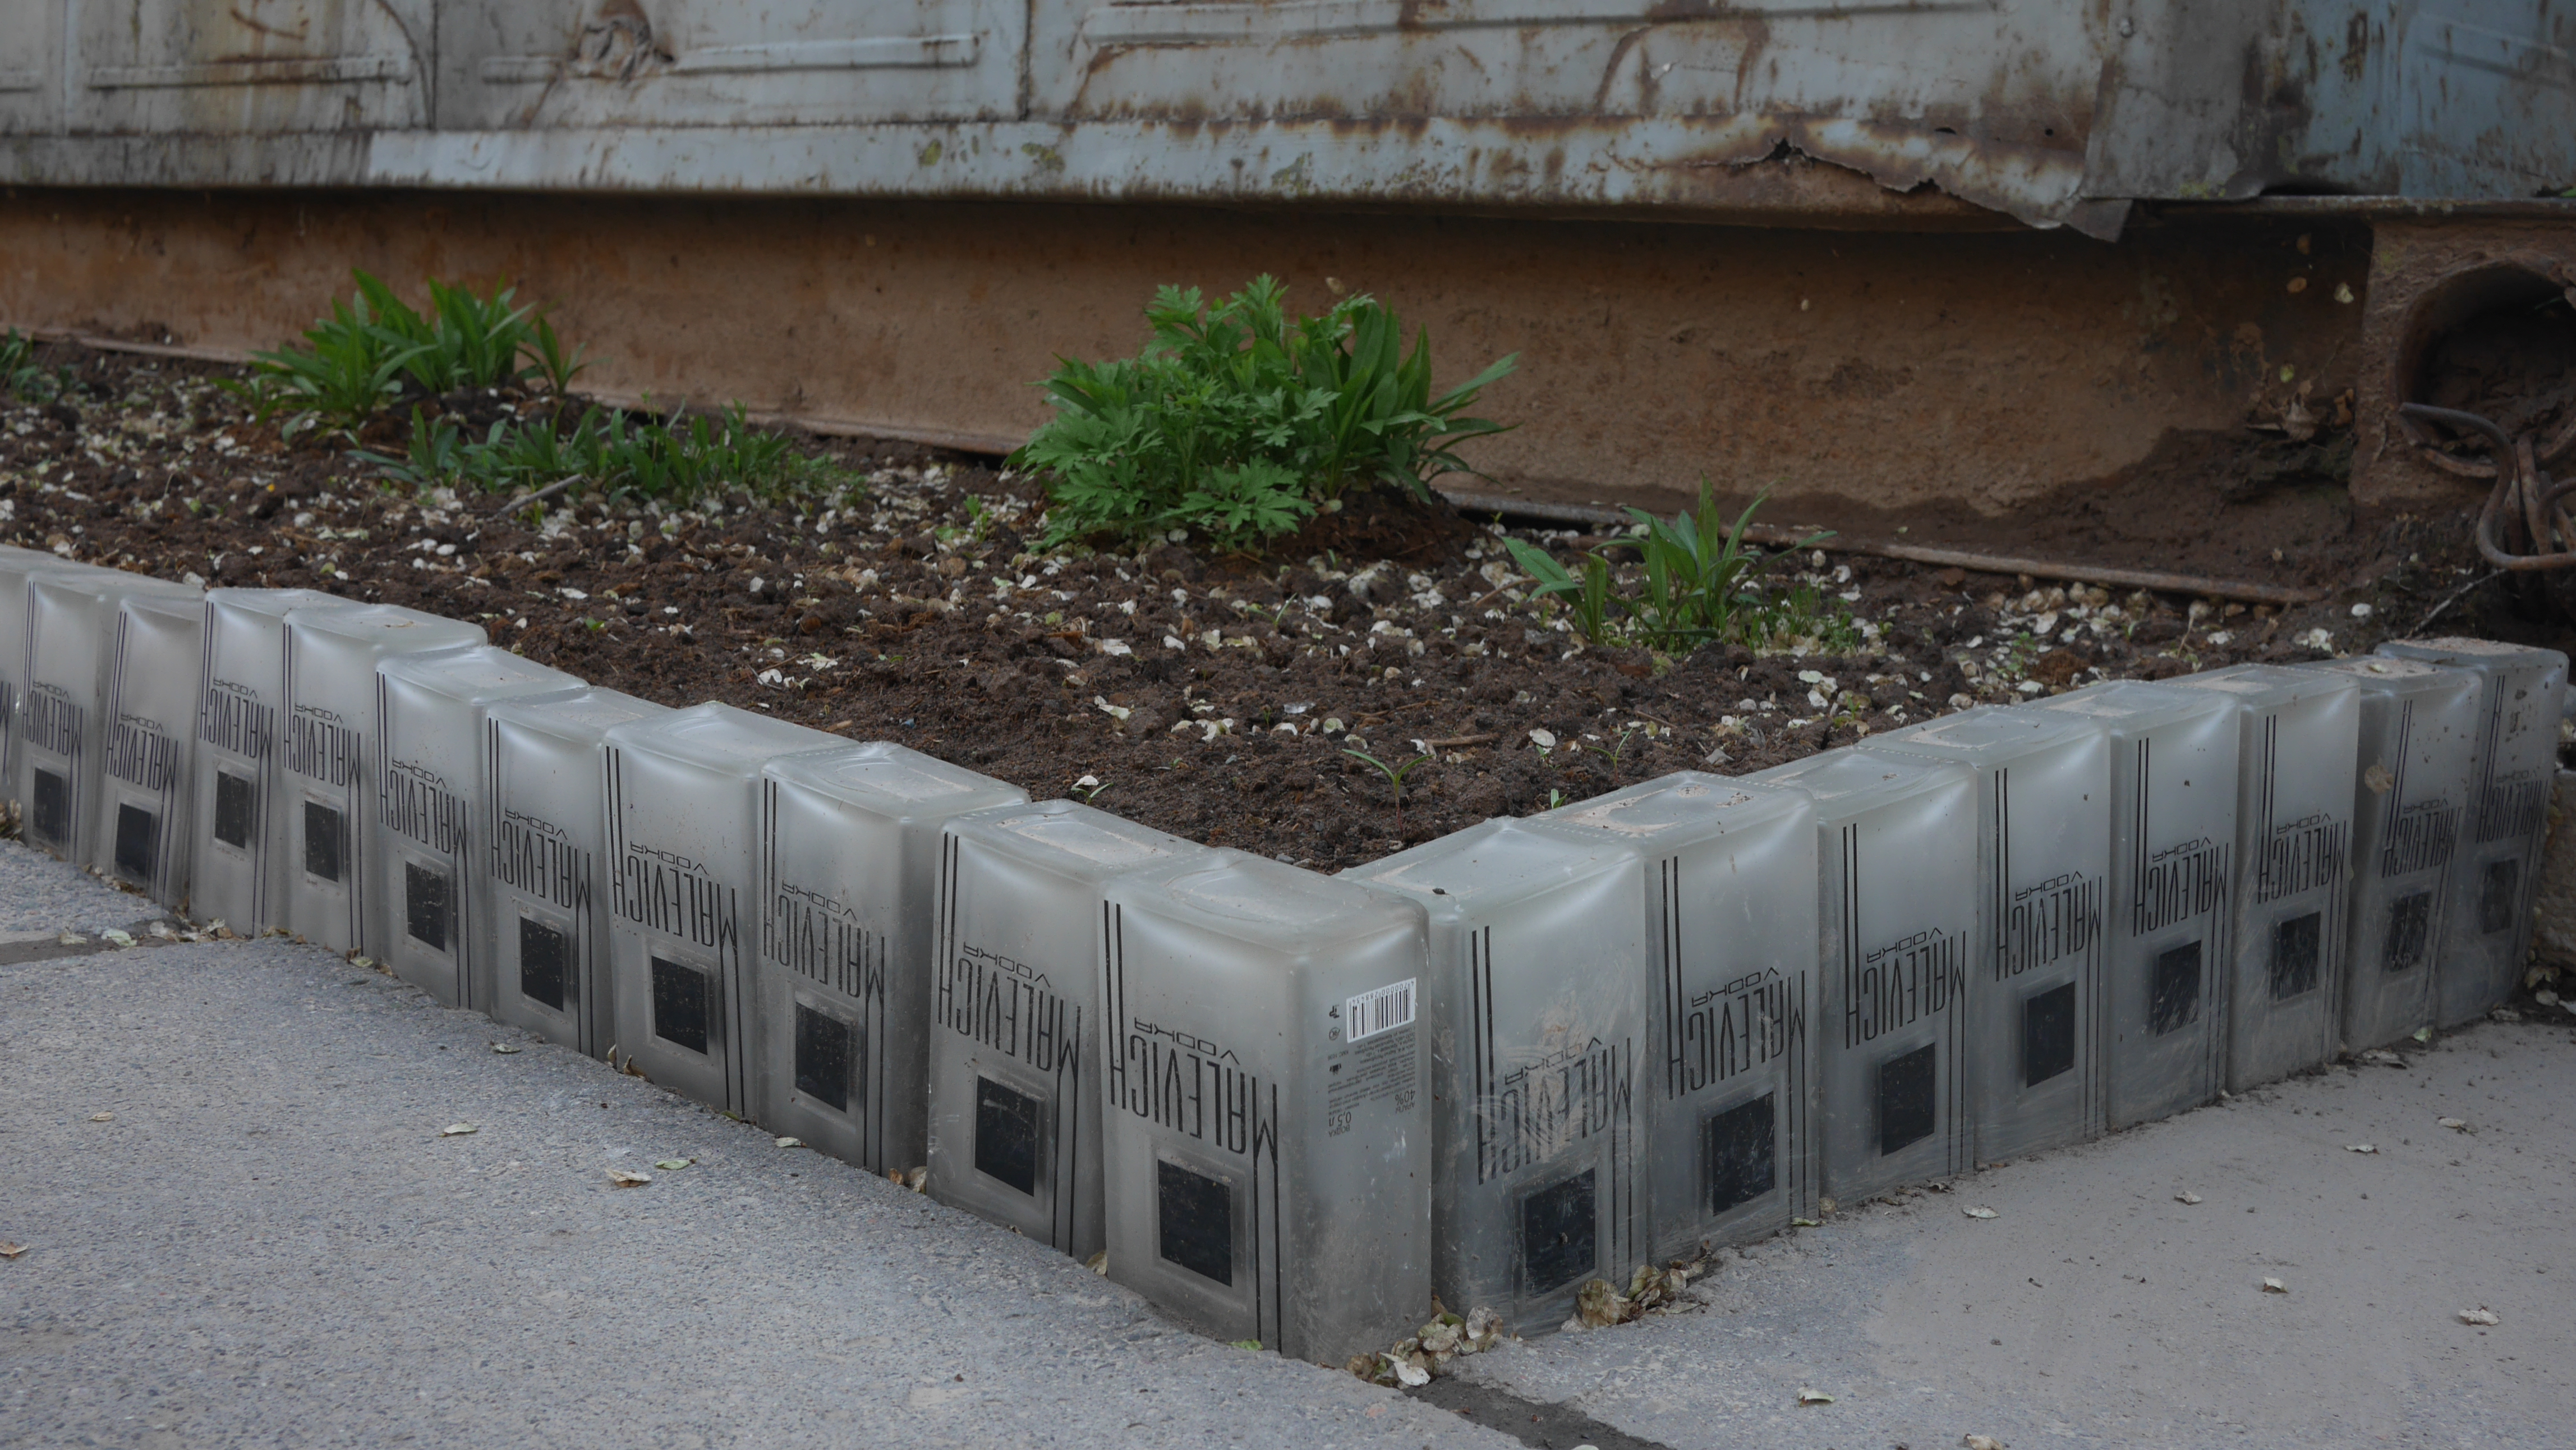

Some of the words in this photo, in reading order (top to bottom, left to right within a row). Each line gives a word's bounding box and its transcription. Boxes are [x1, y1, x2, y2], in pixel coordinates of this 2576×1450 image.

[33, 680, 69, 699] VODKA
[213, 678, 257, 699] VODKA
[120, 713, 163, 732] VODKA
[295, 703, 343, 724] VODKA
[392, 758, 447, 788] VODKA
[2404, 798, 2448, 813] VODKA
[505, 807, 568, 839] VODKA
[2277, 813, 2330, 834] VODKA
[630, 840, 709, 874] VODKA
[2152, 837, 2211, 862] VODKA
[2015, 871, 2083, 901] VODKA
[781, 880, 858, 920] VODKA
[1866, 928, 1943, 963] VODKA
[963, 942, 1051, 986] VODKA
[1382, 982, 1407, 995] 700000
[1691, 967, 1779, 1007] VODKA
[1134, 1017, 1240, 1064] VODKA
[1395, 1090, 1415, 1105] 40%
[1328, 1123, 1350, 1137] ВОДКА
[1338, 1111, 1351, 1126] 0,5
